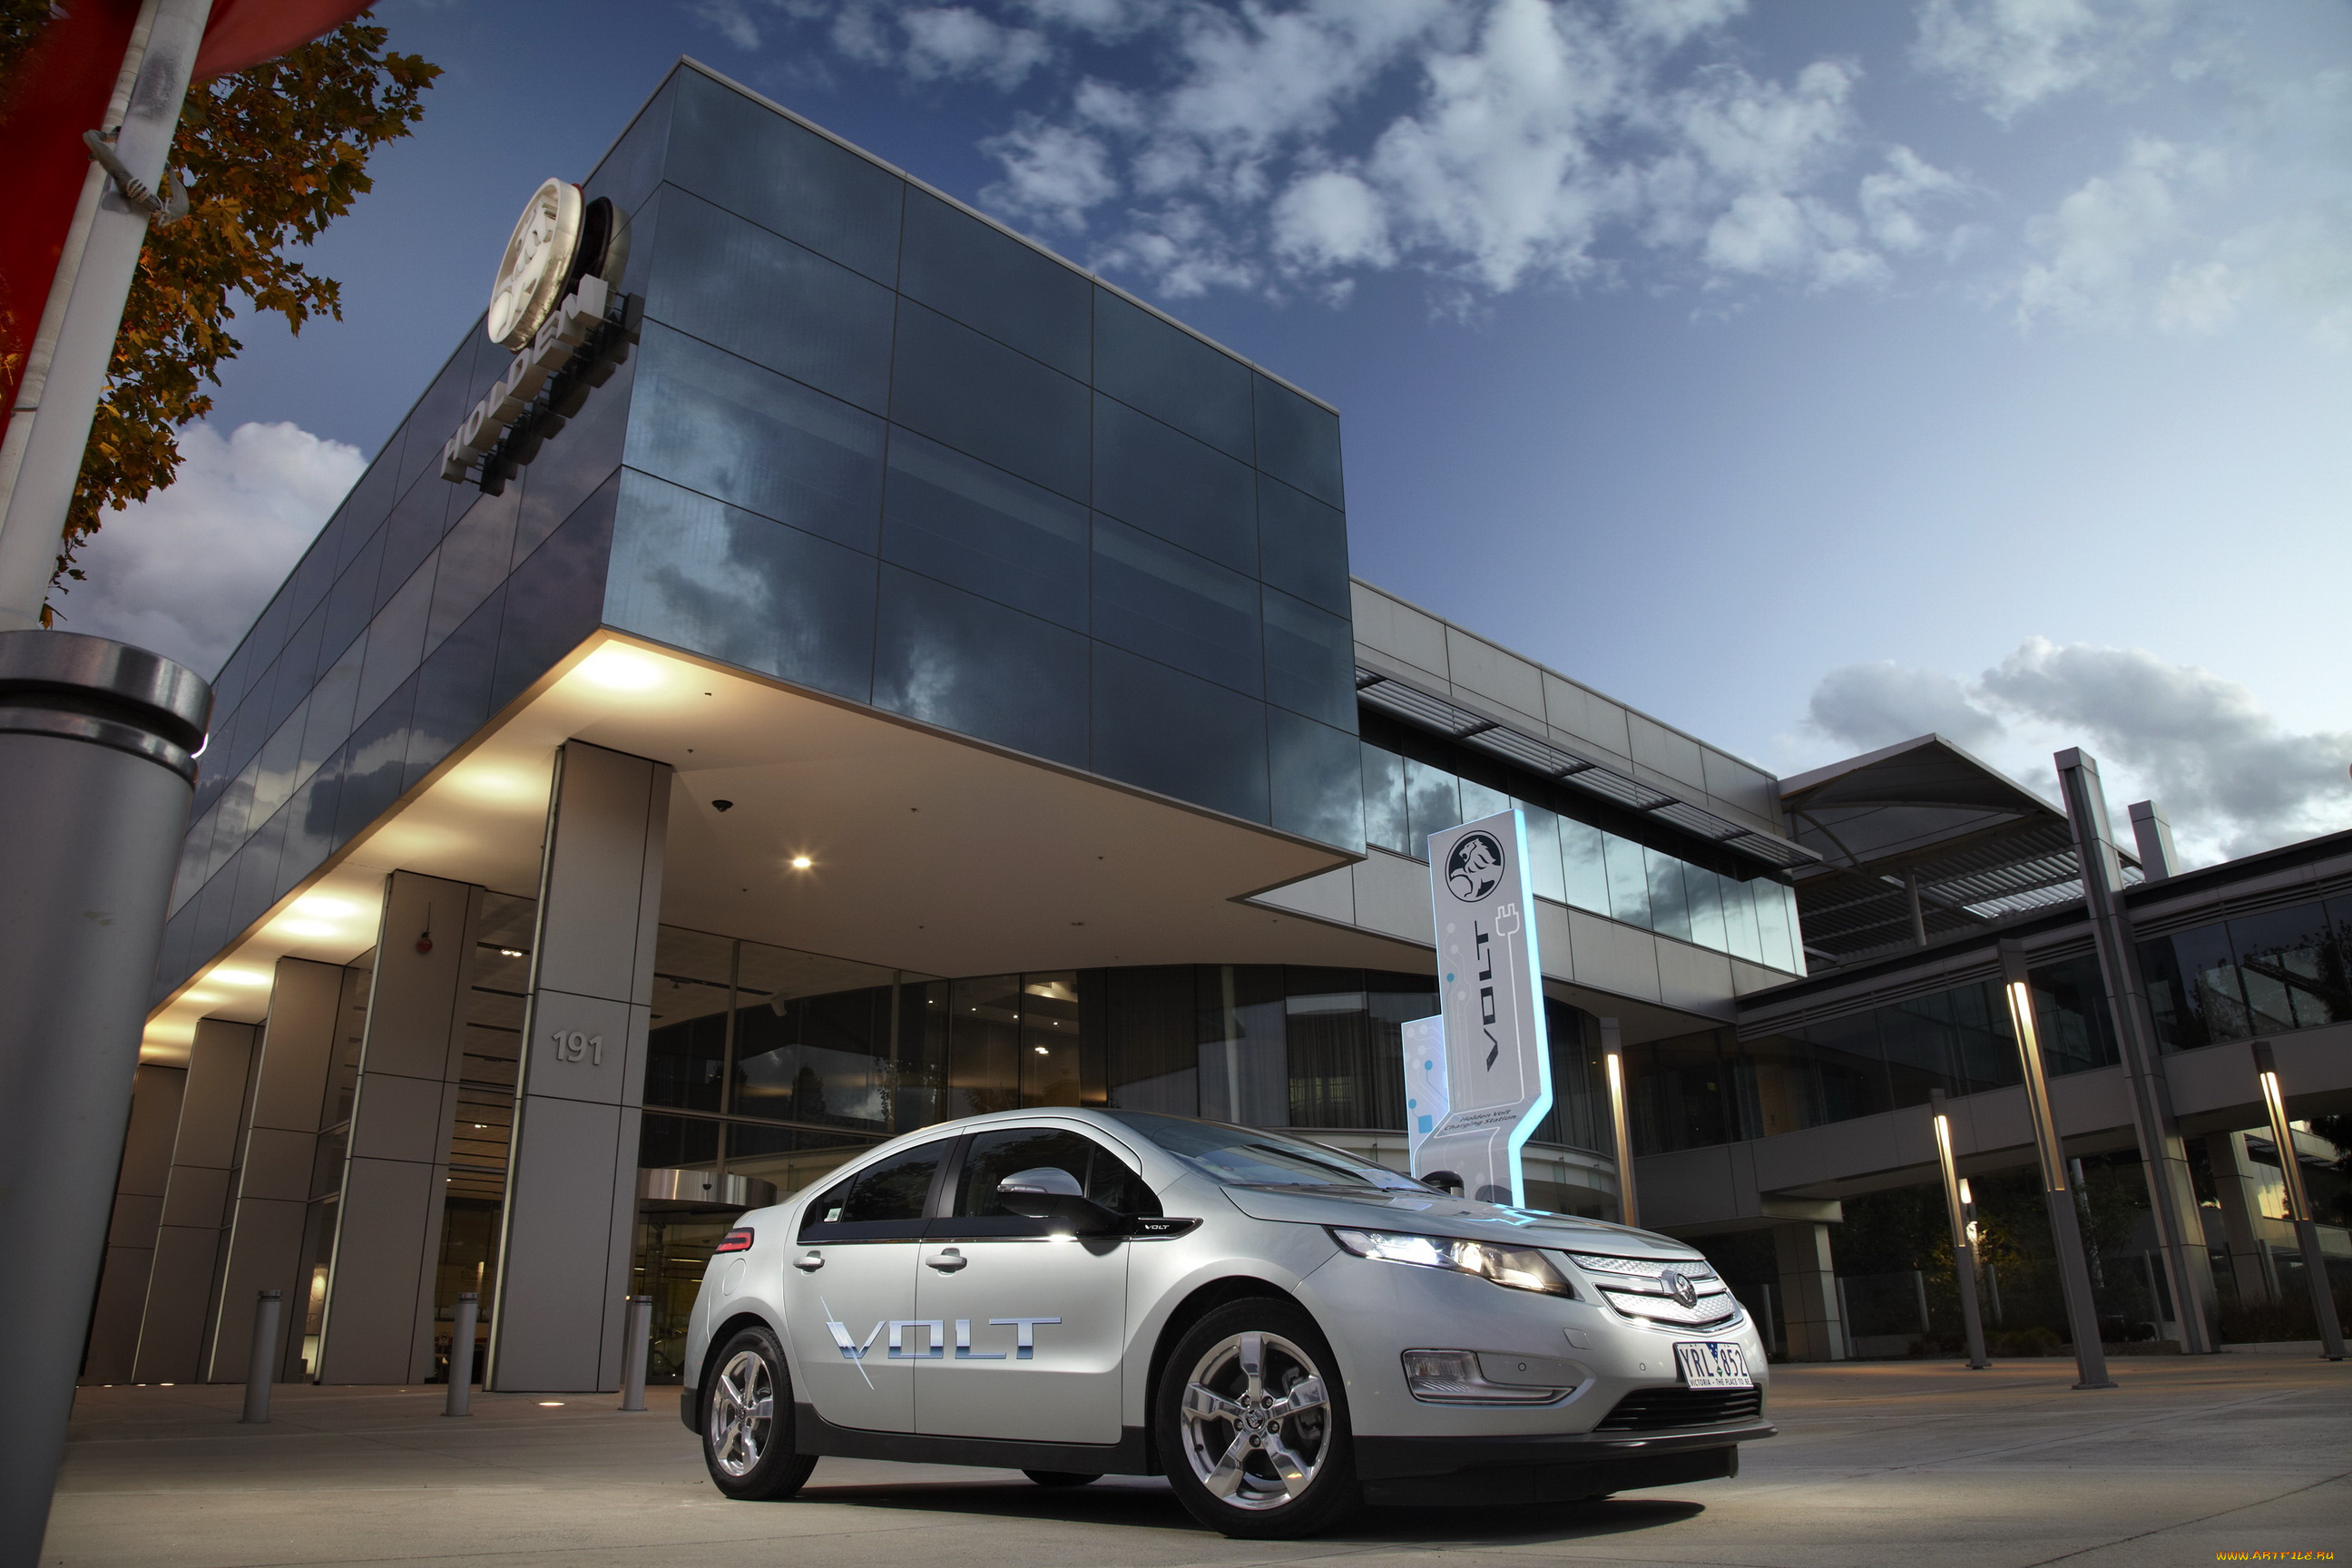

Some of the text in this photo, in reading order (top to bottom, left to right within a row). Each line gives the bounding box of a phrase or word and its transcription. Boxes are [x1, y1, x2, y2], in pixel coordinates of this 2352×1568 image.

[440, 273, 608, 485] HOLDEN
[1474, 919, 1499, 1073] VOLT
[552, 1030, 603, 1065] 191
[1444, 1114, 1516, 1131] Charging Station
[1459, 1109, 1511, 1122] Holden Volt
[825, 1317, 1063, 1359] VOLT
[1679, 1348, 1748, 1377] YRL 852
[1690, 1378, 1711, 1387] VICTORIA
